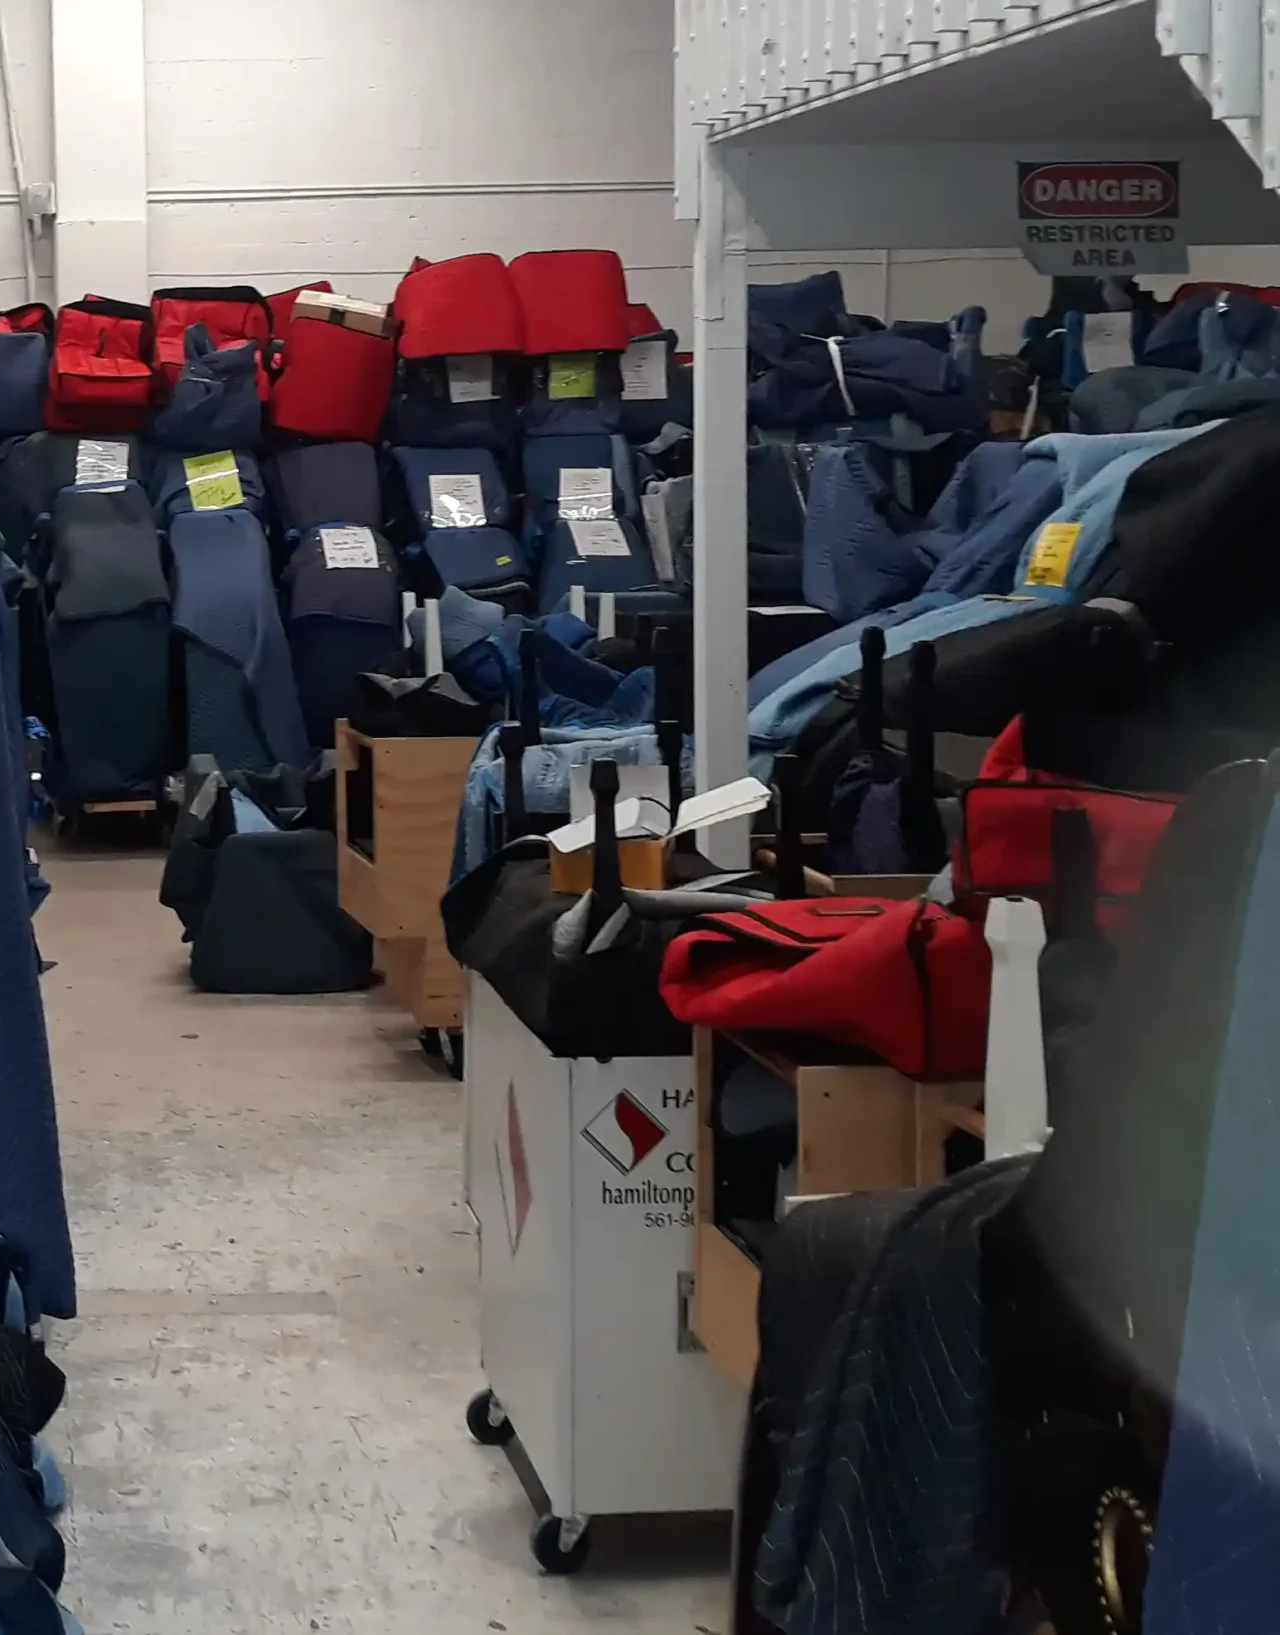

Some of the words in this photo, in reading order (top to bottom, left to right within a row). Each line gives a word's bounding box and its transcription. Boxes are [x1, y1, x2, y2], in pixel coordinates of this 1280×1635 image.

[1034, 179, 1164, 202] DANGER
[1026, 224, 1175, 243] RESTRICTED
[1072, 248, 1137, 267] AREA
[602, 1179, 695, 1211] hamiltonp
